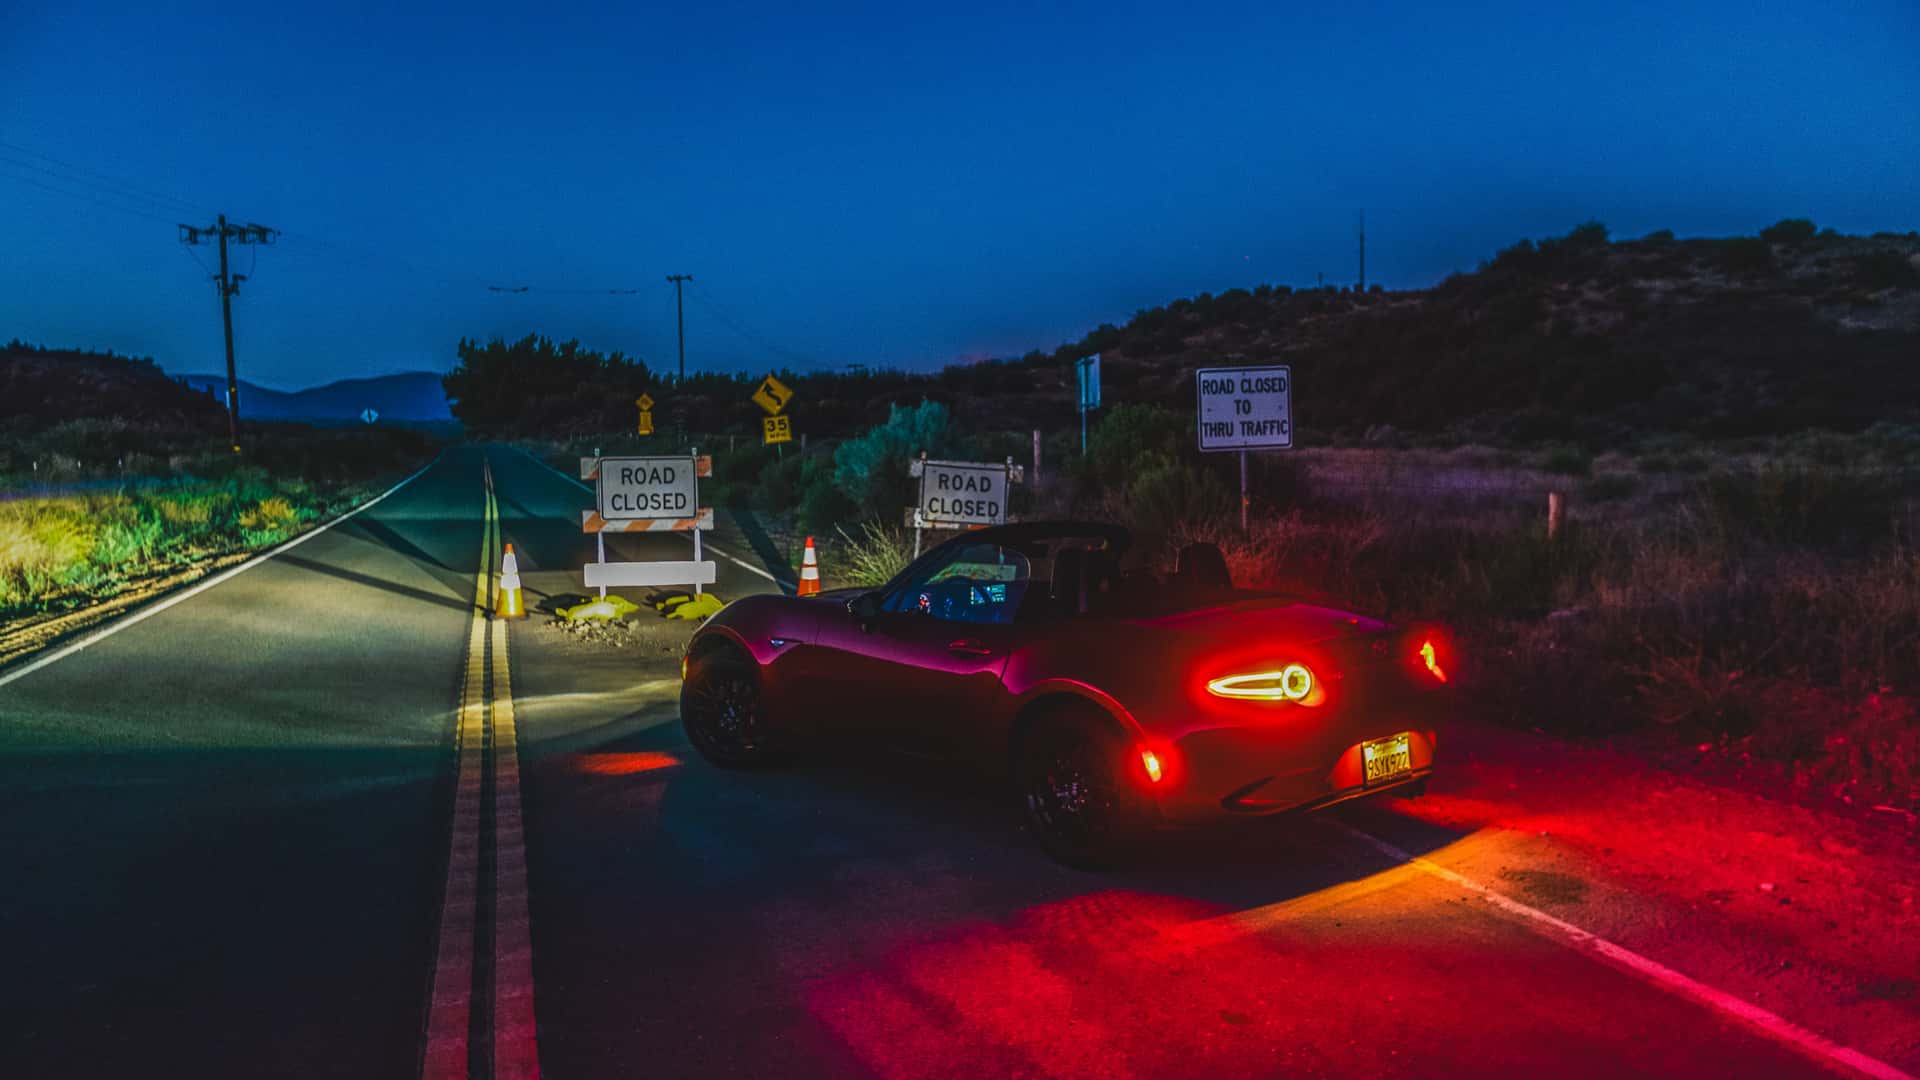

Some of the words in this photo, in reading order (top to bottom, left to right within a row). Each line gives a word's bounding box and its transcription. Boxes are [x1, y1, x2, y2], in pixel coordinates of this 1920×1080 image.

[1202, 379, 1234, 395] ROAD
[1241, 377, 1286, 394] CLOSED
[1234, 399, 1252, 415] TO
[767, 419, 787, 432] 35
[1202, 421, 1234, 438] THRU
[1240, 420, 1288, 437] TRAFFIC
[621, 467, 675, 485] ROAD
[938, 473, 991, 493] ROAD
[611, 493, 687, 511] CLOSED
[928, 497, 999, 518] CLOSED
